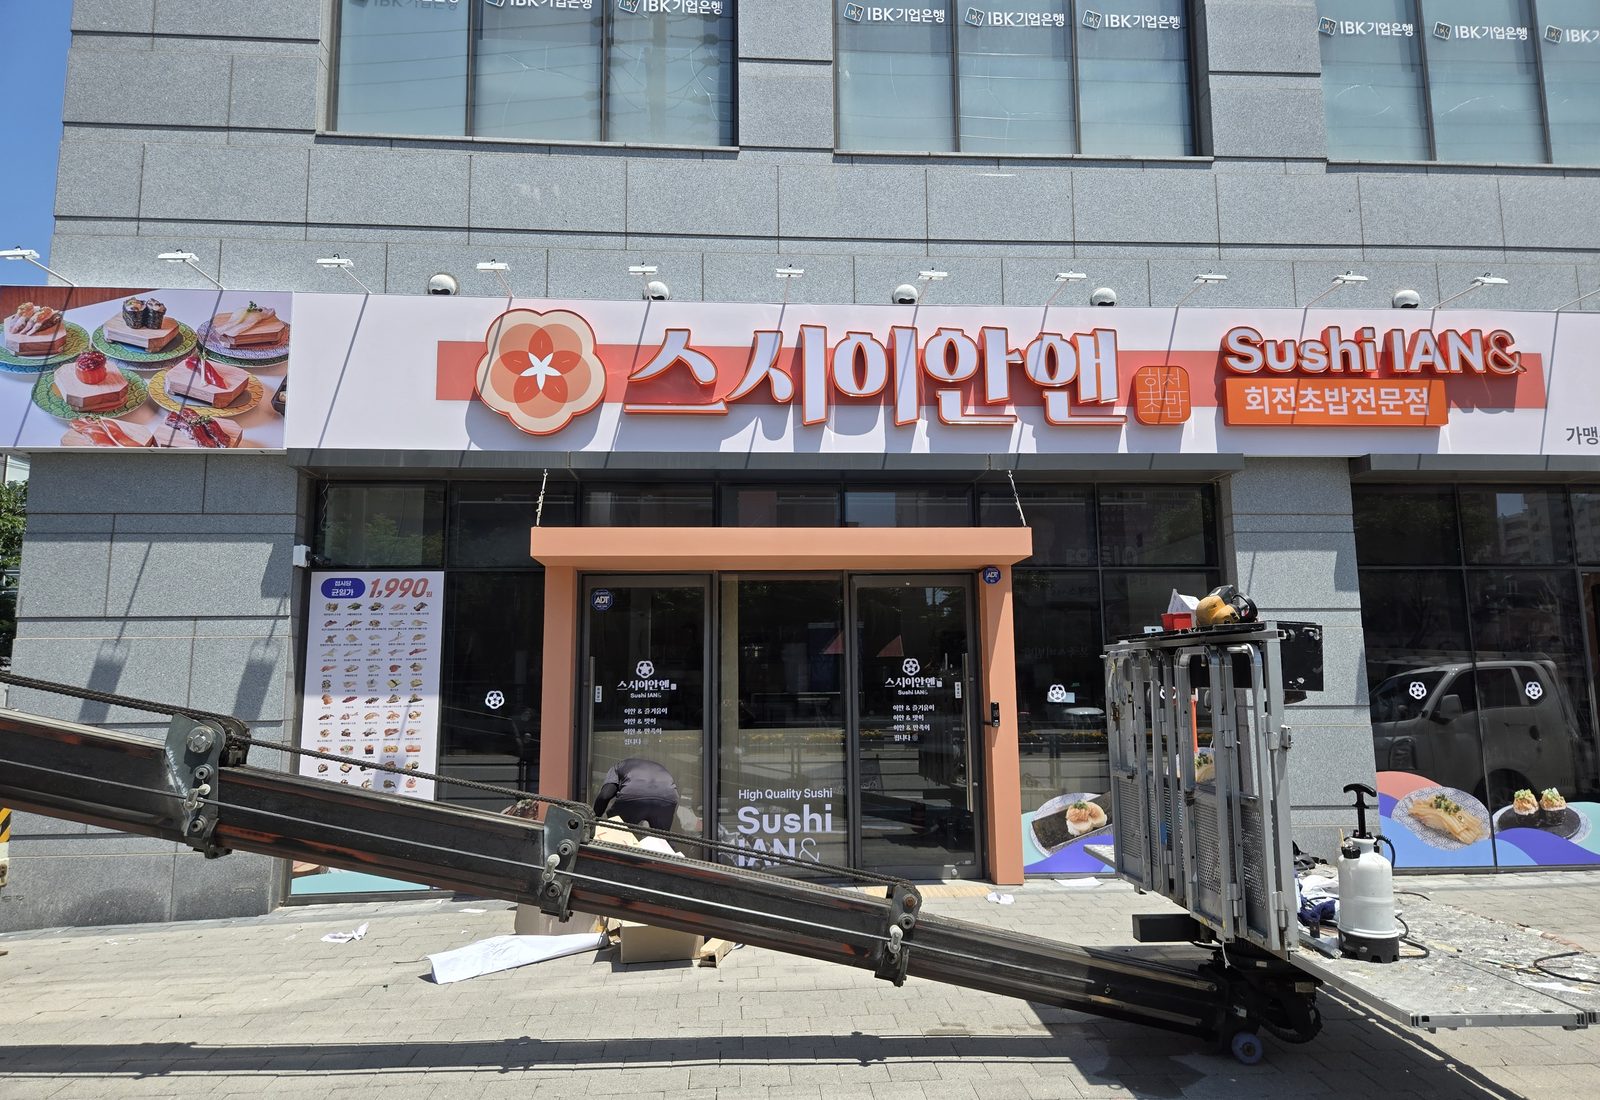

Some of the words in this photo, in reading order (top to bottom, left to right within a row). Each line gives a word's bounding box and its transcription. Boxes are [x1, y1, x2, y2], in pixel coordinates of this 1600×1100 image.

[866, 7, 946, 23] IBK기업은행
[987, 11, 1065, 27] IBK기업은행
[1339, 20, 1414, 37] IBK기업은행
[1454, 25, 1528, 41] IBK기업은행
[1223, 326, 1378, 375] Sushi
[1386, 328, 1527, 376] IAN&
[624, 324, 1127, 427] 스시이안앤
[1244, 386, 1430, 417] 회전초밥전문점
[1565, 425, 1600, 446] 가맹
[331, 588, 354, 597] 균일가
[594, 595, 610, 604] ADT
[616, 679, 670, 691] 스시이안앤
[884, 676, 936, 688] 스시이안앤
[892, 704, 904, 712] 이안
[738, 789, 763, 801] High
[764, 788, 802, 801] Quality
[803, 787, 833, 799] Sushi
[737, 803, 832, 835] Sushi
